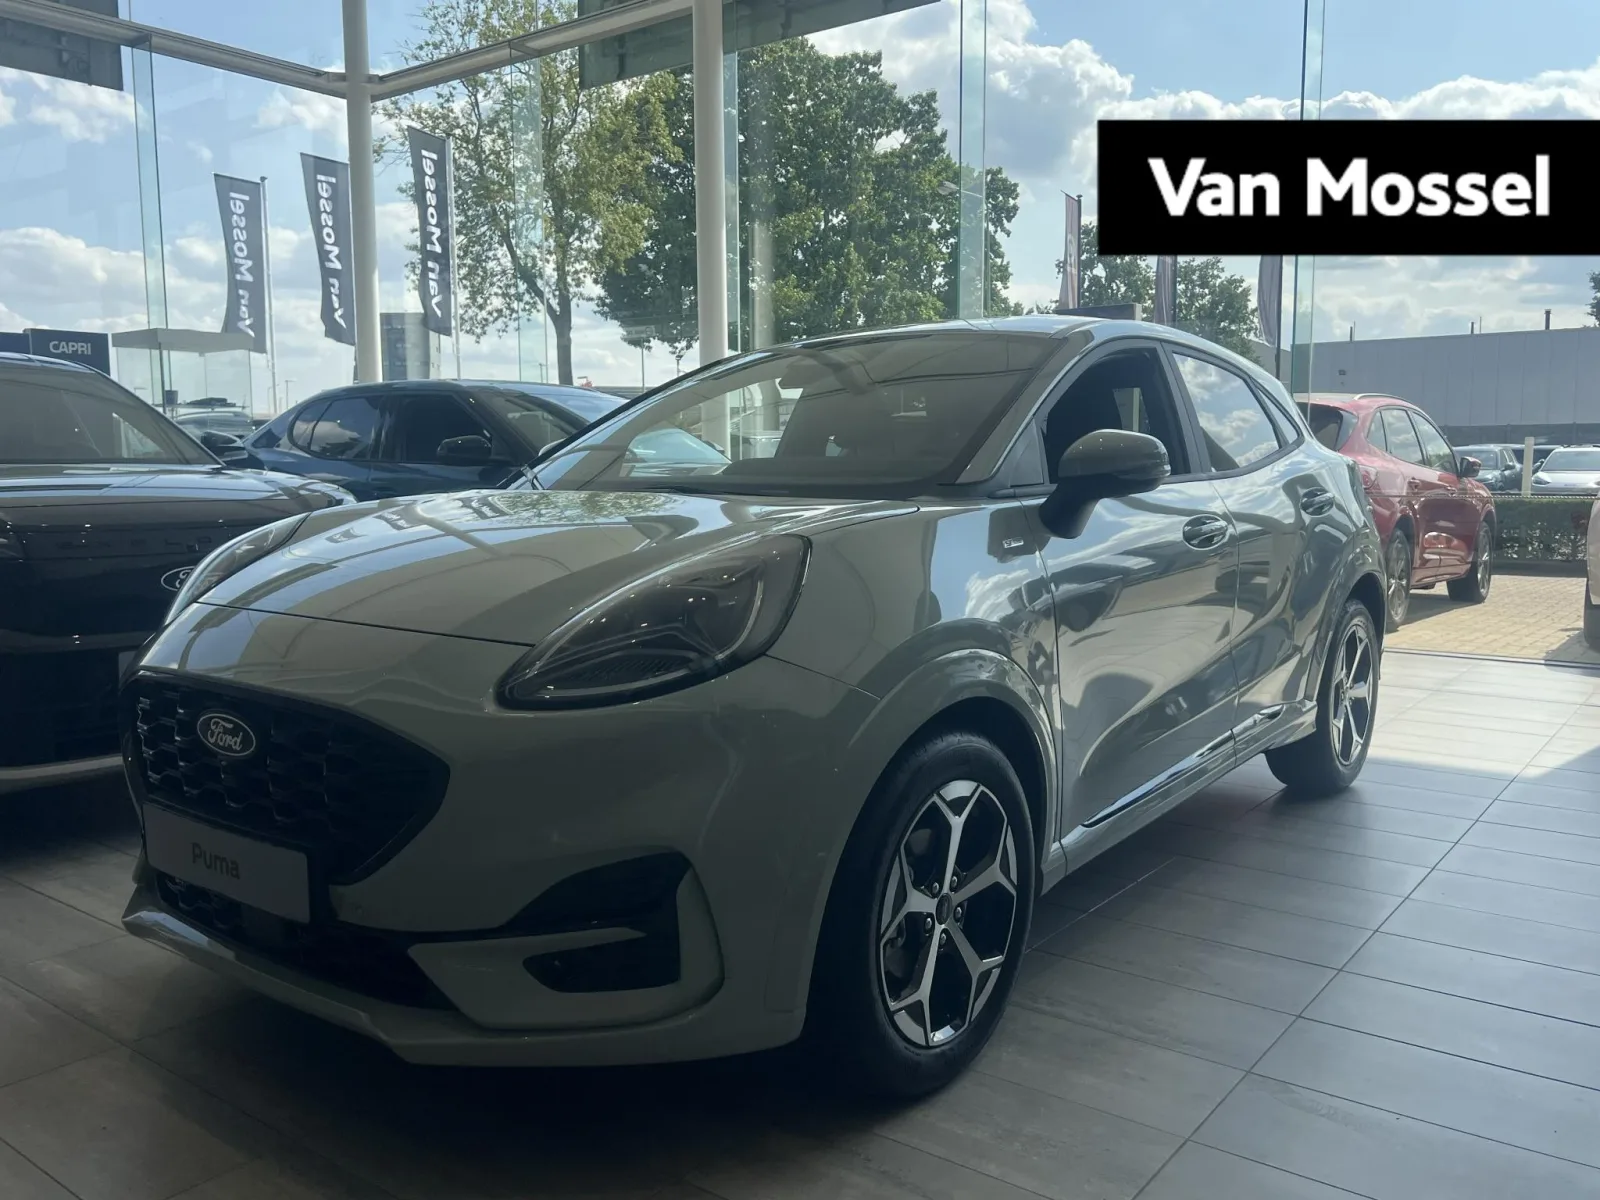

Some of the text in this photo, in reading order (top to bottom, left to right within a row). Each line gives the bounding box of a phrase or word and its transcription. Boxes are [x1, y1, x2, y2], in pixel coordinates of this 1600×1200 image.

[49, 341, 91, 355] CAPRI
[207, 718, 243, 750] Ford
[191, 842, 240, 880] Puma
